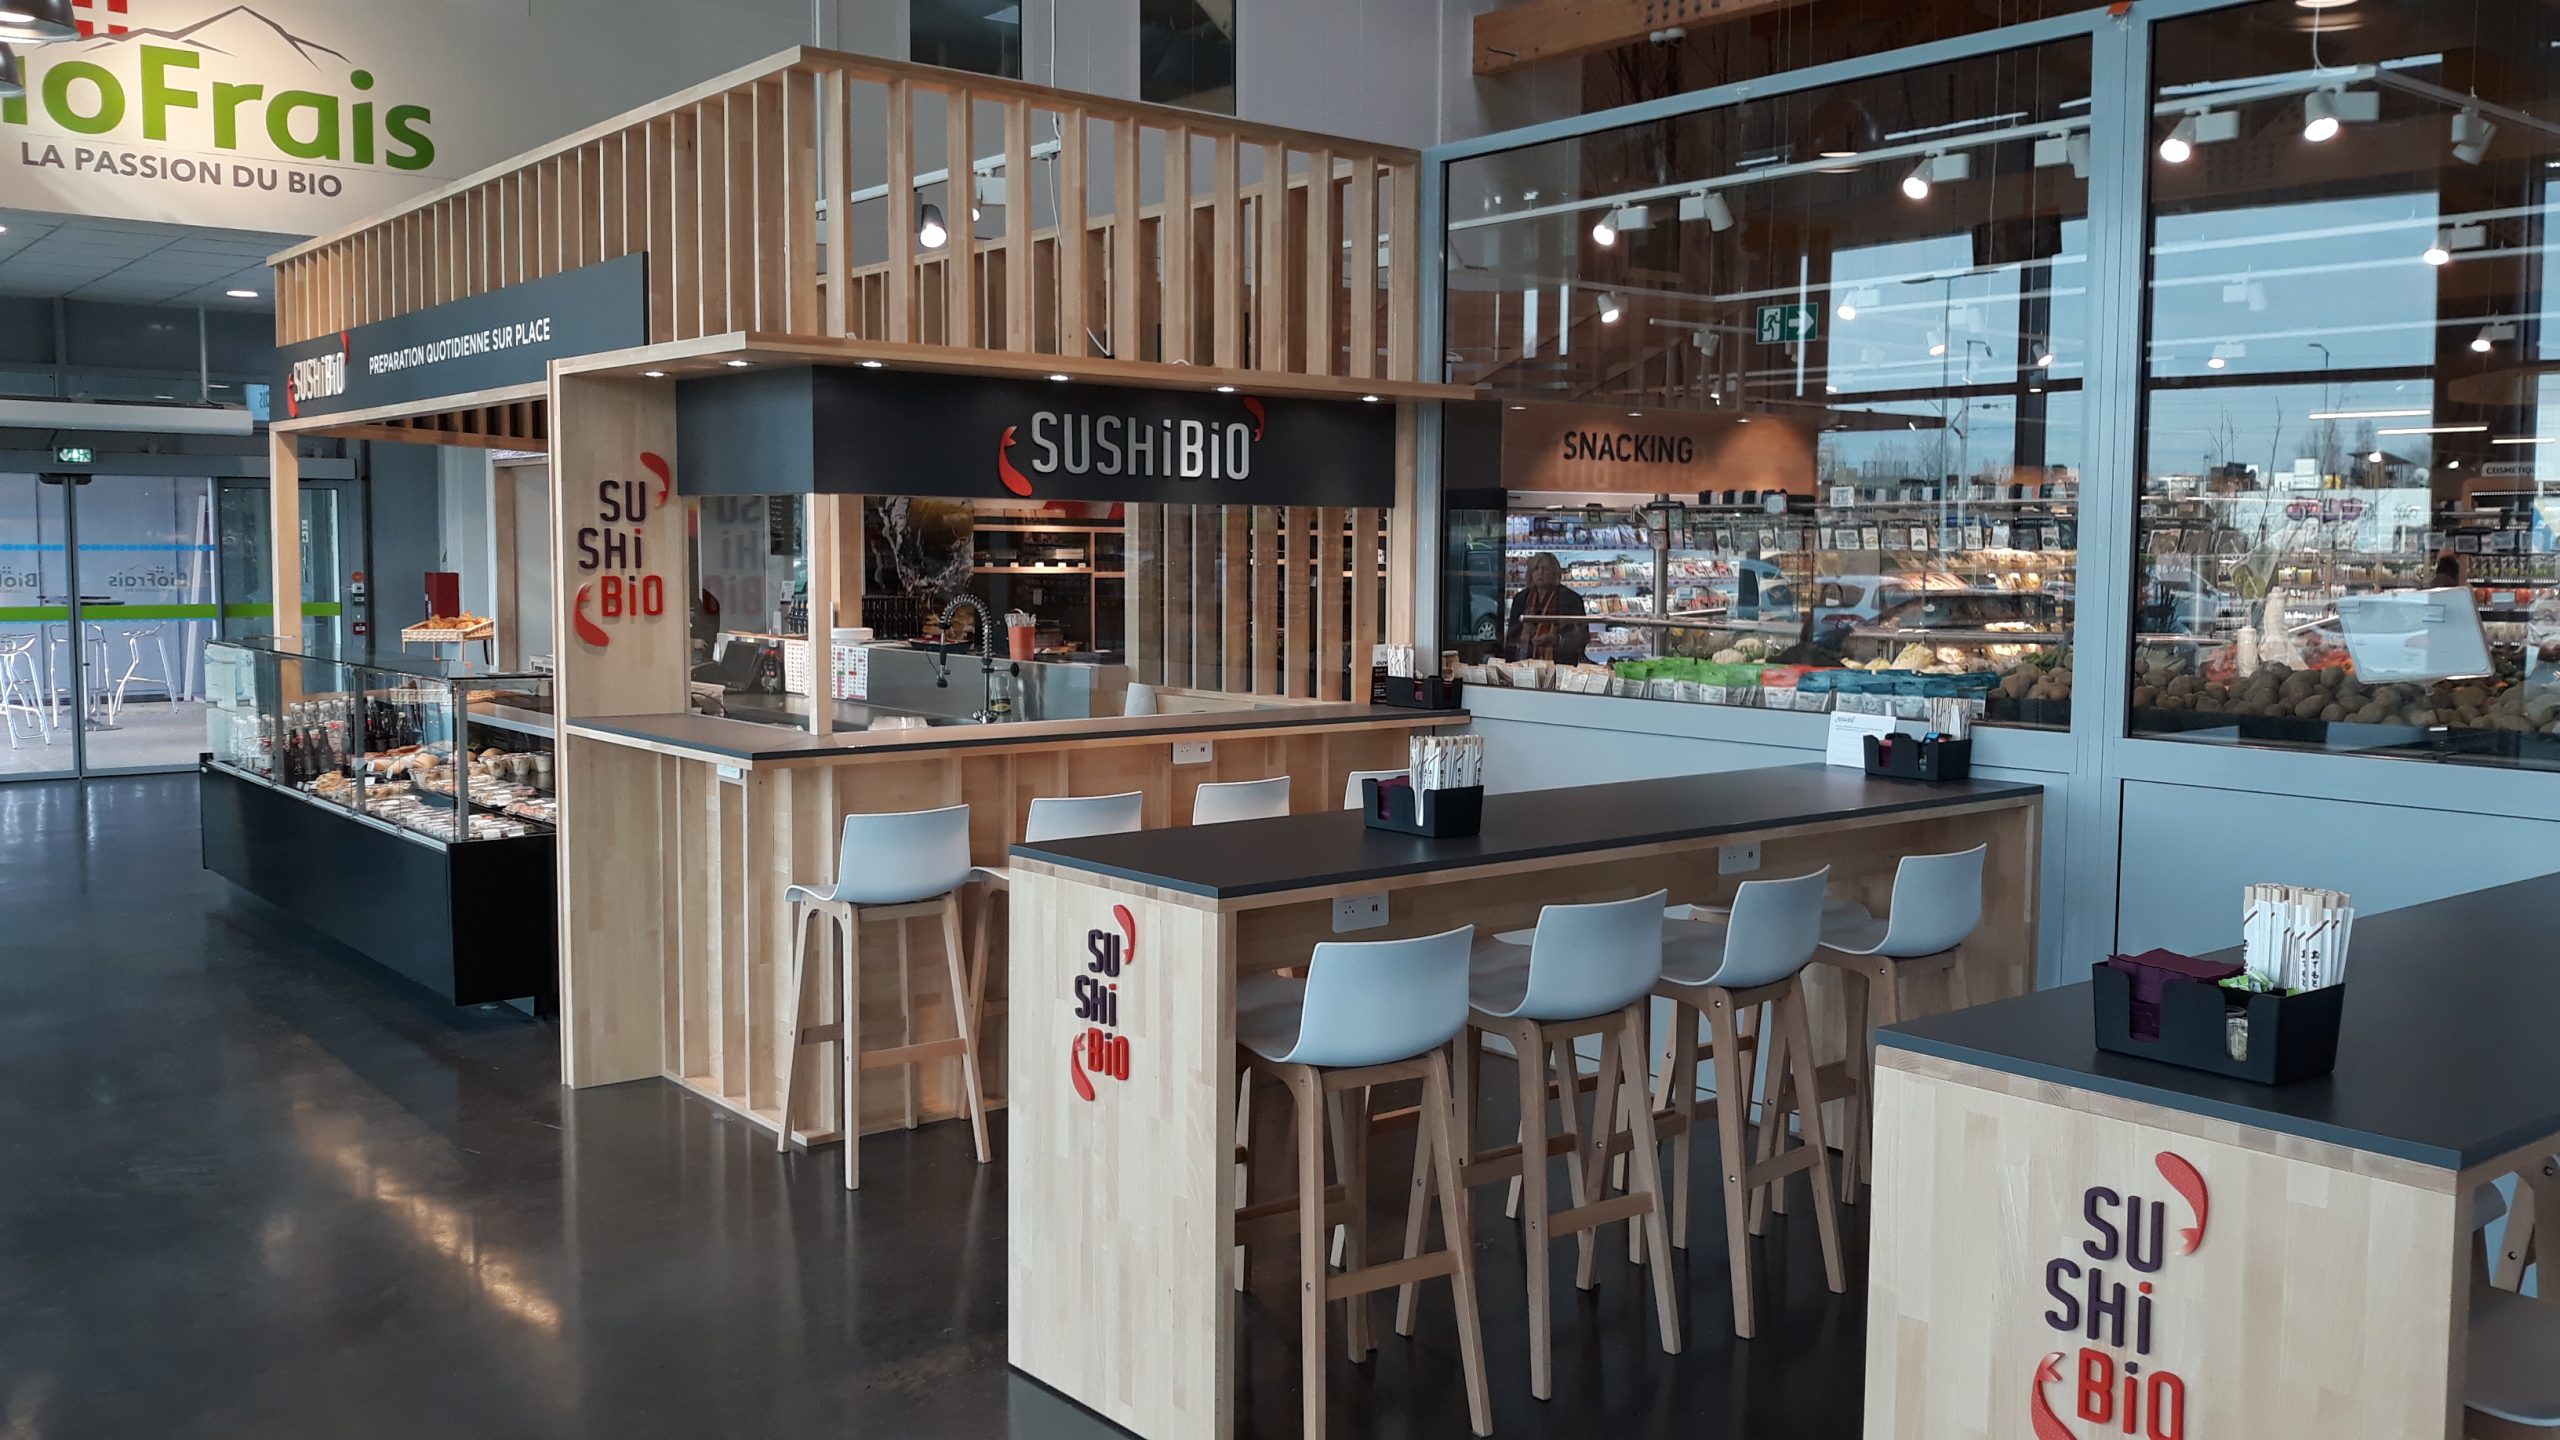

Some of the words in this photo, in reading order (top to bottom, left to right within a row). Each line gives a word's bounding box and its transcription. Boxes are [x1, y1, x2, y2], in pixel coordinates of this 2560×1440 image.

[21, 141, 65, 169] LA
[75, 147, 222, 185] PASSION
[233, 165, 278, 192] DU
[288, 173, 342, 197] BIO
[369, 345, 425, 375] PREPARATION
[426, 330, 490, 364] QUOTIDIENNE
[492, 326, 513, 350] SUR
[515, 317, 551, 345] PLACE
[1563, 431, 1693, 464] SNACKING
[600, 480, 646, 522] SU
[1088, 929, 1120, 977] SU
[2083, 1186, 2164, 1273] SU
